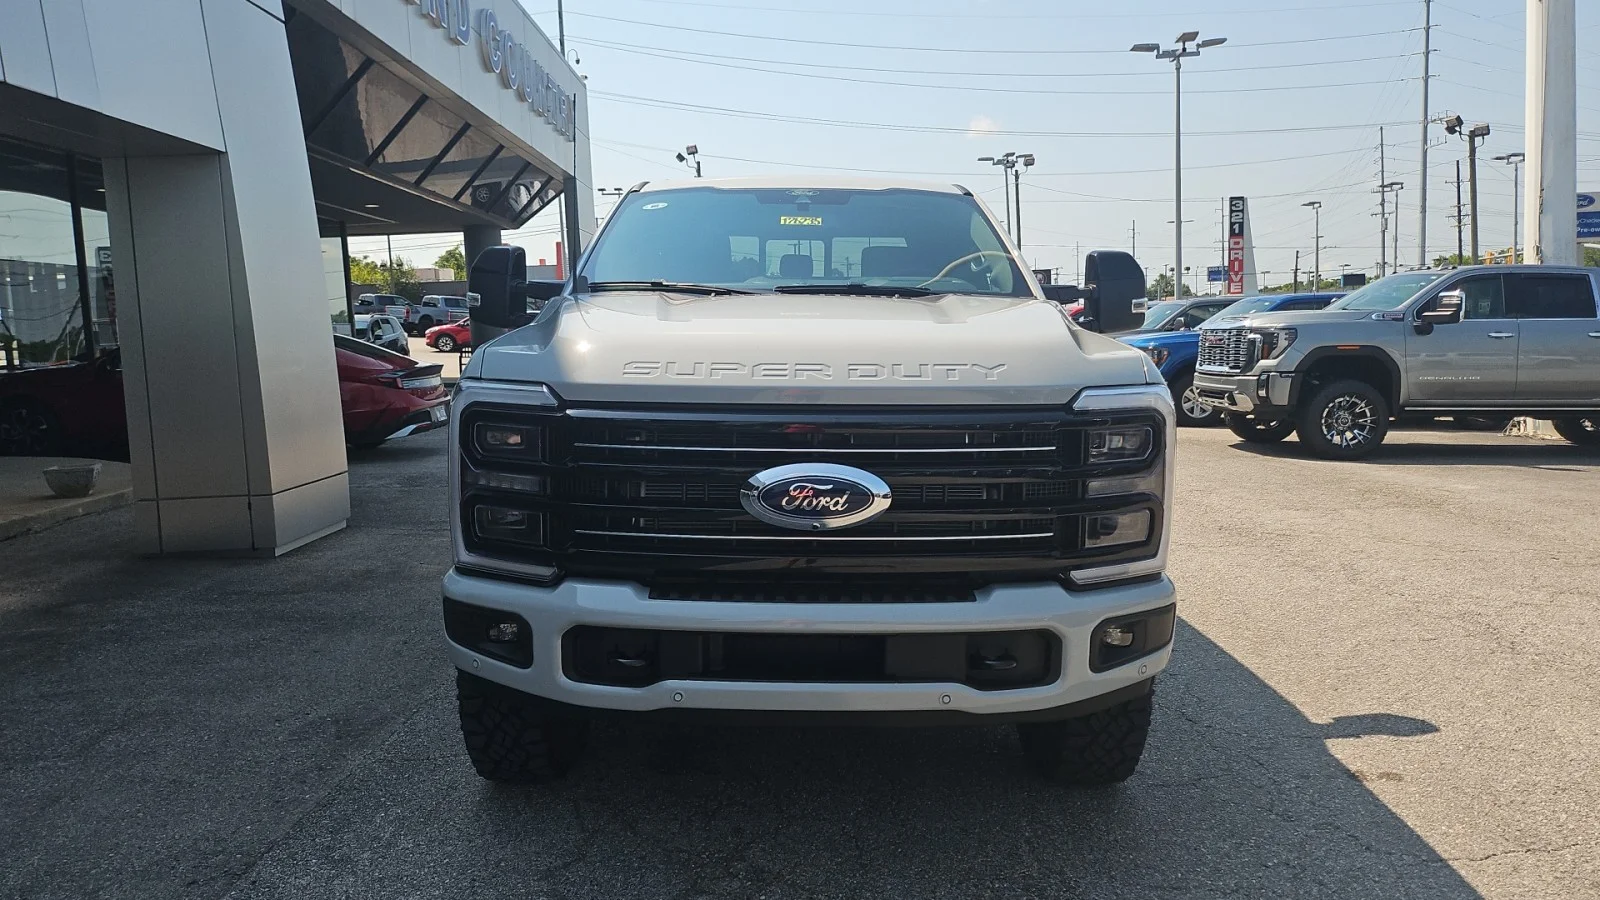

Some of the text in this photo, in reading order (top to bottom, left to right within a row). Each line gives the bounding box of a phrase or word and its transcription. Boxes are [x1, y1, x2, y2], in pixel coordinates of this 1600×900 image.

[480, 9, 573, 142] COUNTR
[1229, 200, 1244, 293] 321 DRIVE
[622, 360, 1008, 381] SUPER DUTY
[781, 482, 851, 511] Ford
